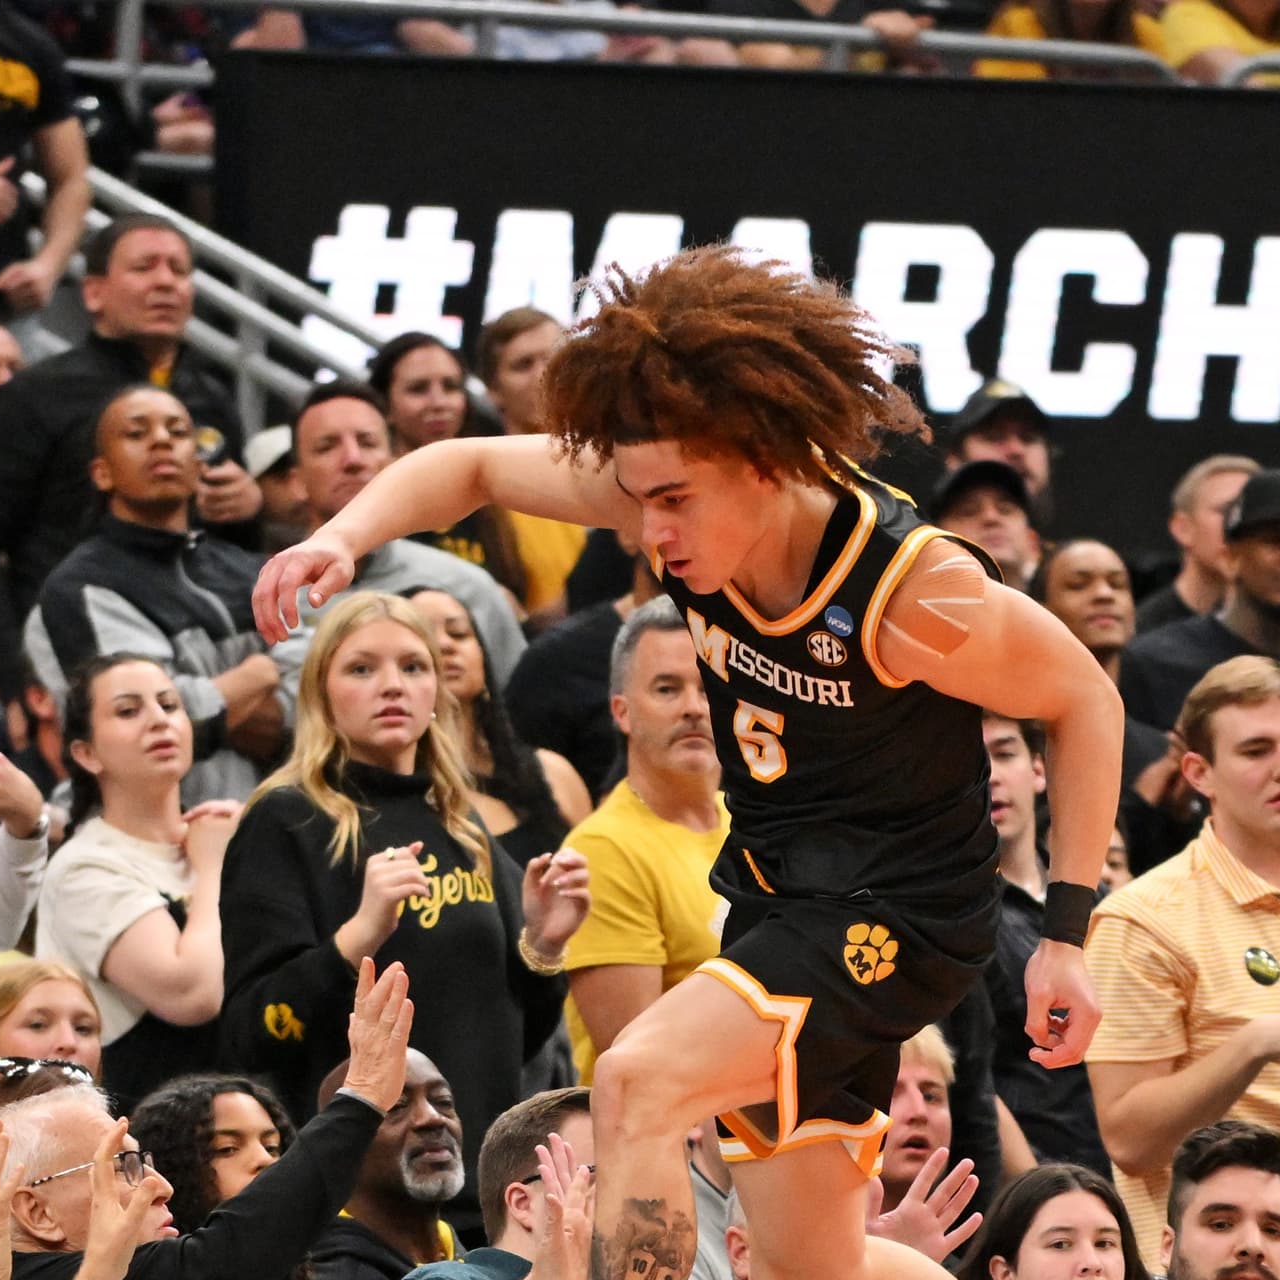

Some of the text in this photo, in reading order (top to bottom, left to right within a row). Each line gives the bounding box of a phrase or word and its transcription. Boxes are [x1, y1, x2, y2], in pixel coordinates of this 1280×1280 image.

[686, 606, 855, 707] MISSOURI
[810, 633, 844, 664] SEC
[733, 698, 788, 784] 5
[632, 1258, 647, 1274] 10
